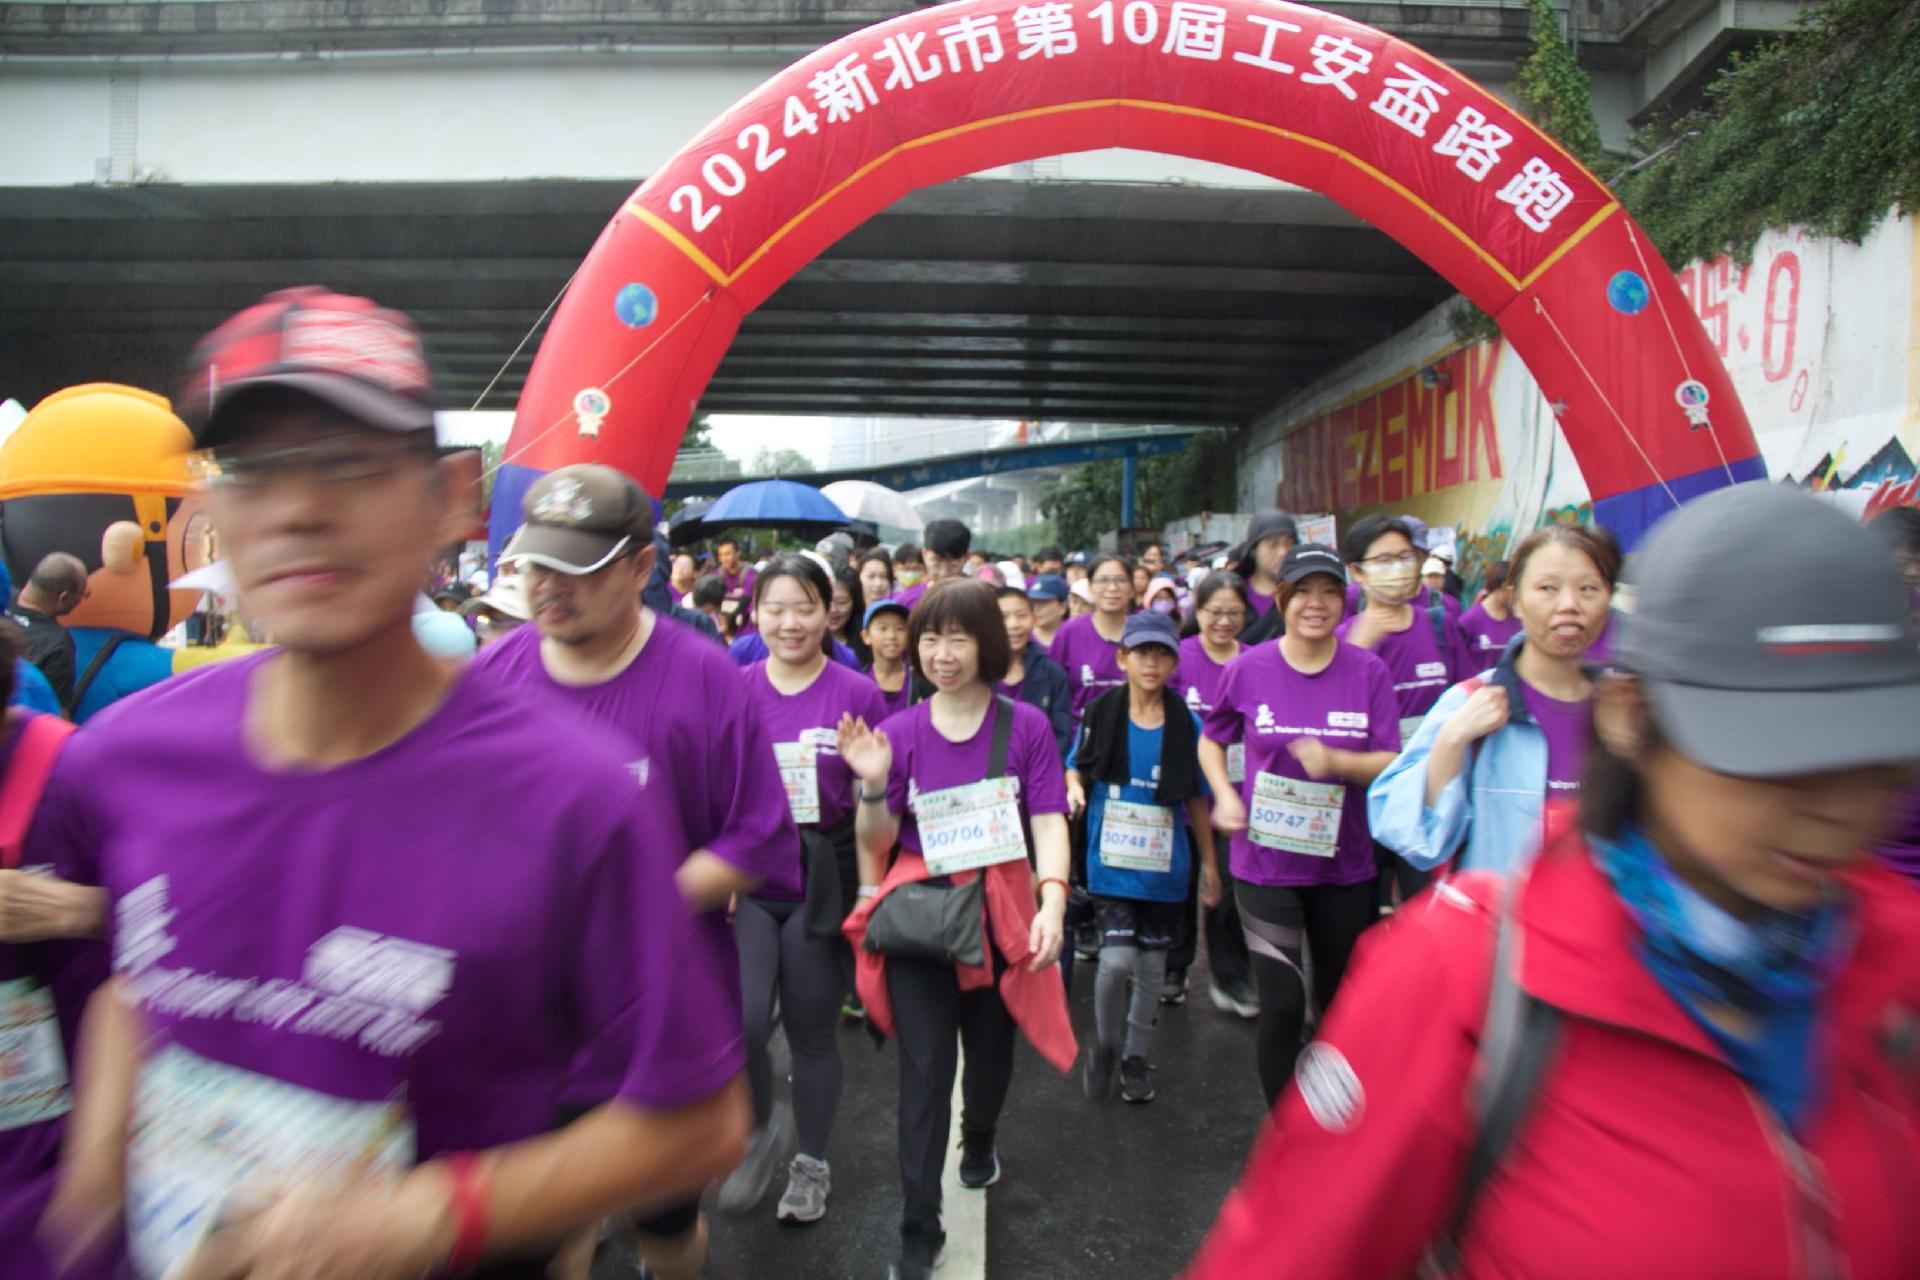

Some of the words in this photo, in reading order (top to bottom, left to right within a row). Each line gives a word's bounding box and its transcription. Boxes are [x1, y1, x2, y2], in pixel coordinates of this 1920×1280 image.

[1254, 807, 1307, 828] 50747
[926, 824, 984, 849] 50706
[1103, 831, 1147, 849] 50748
